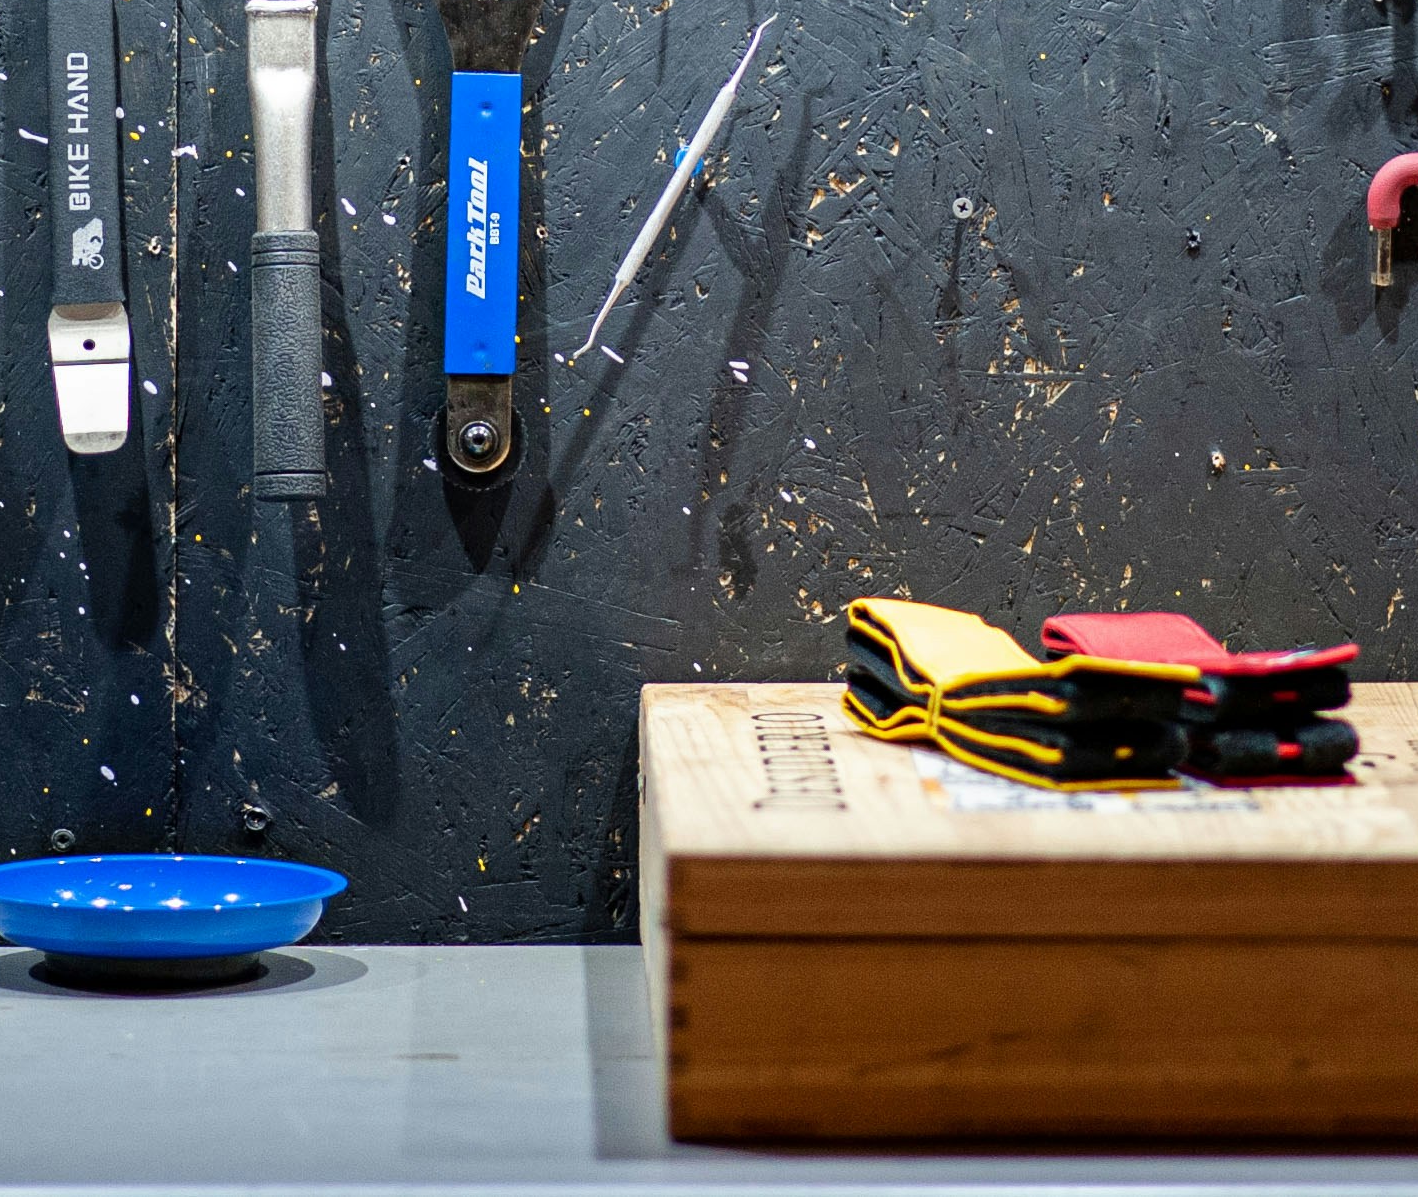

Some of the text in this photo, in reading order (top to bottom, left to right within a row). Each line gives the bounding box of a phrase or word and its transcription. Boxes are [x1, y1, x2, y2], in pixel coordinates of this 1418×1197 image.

[66, 52, 91, 211] BIKE HAND
[466, 157, 488, 299] ParkTool
[489, 212, 500, 245] BBT-9
